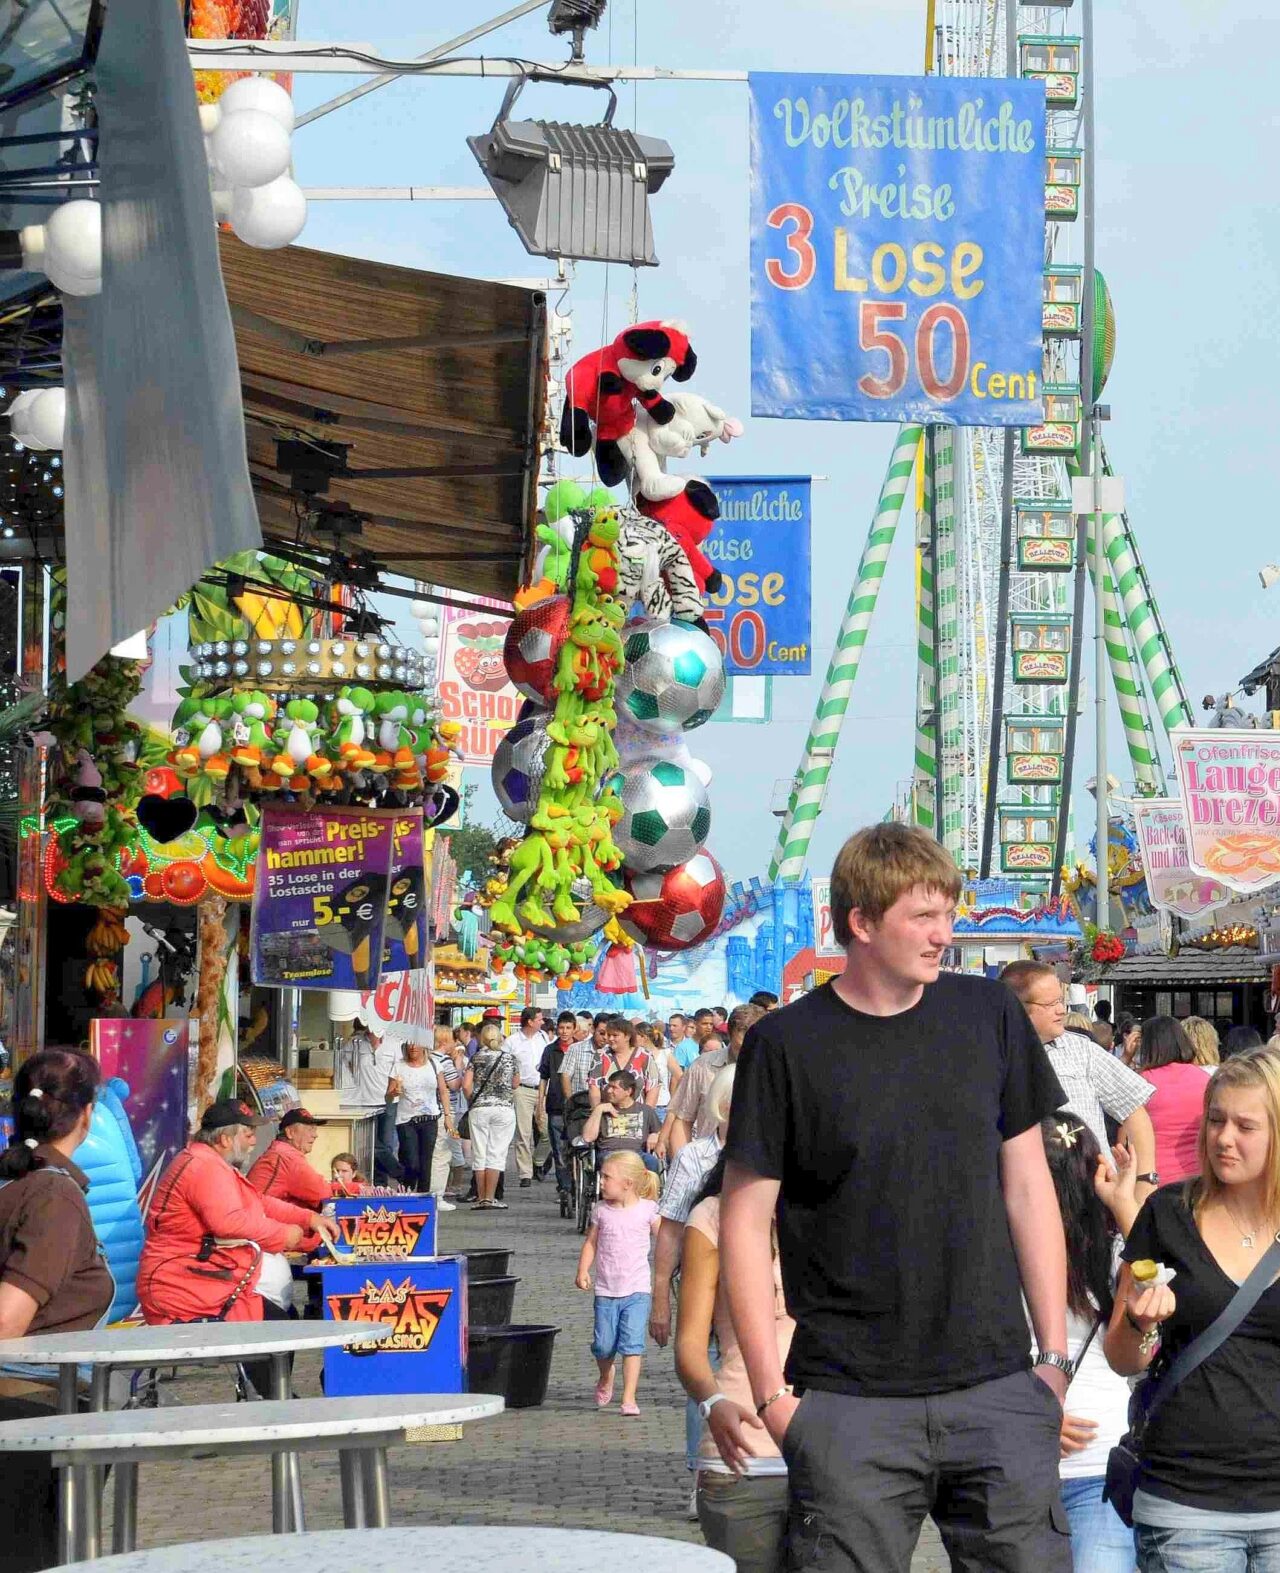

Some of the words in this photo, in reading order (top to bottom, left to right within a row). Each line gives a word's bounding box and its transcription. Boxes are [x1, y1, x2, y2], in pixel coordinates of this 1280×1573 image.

[774, 97, 1035, 152] Volkstümliche
[829, 163, 954, 221] Preise
[765, 202, 816, 291] 3
[834, 226, 984, 299] Lose
[858, 300, 970, 401] 50
[971, 363, 1036, 399] Cent
[716, 490, 803, 521] tümliche
[700, 572, 786, 607] ose
[767, 641, 807, 662] Cent
[326, 817, 385, 842] Preis-
[1146, 824, 1186, 846] Back-Ca
[266, 840, 365, 869] hammer!
[1151, 848, 1171, 868] und
[268, 875, 285, 886] 35
[288, 872, 319, 884] Lose
[322, 870, 335, 881] in
[339, 868, 362, 879] der
[269, 883, 335, 898] Lostasche
[292, 918, 310, 928] nur
[356, 903, 374, 921] €
[367, 1212, 397, 1224] LAS
[338, 1213, 430, 1255] VEGAS
[368, 1288, 408, 1303] LAS
